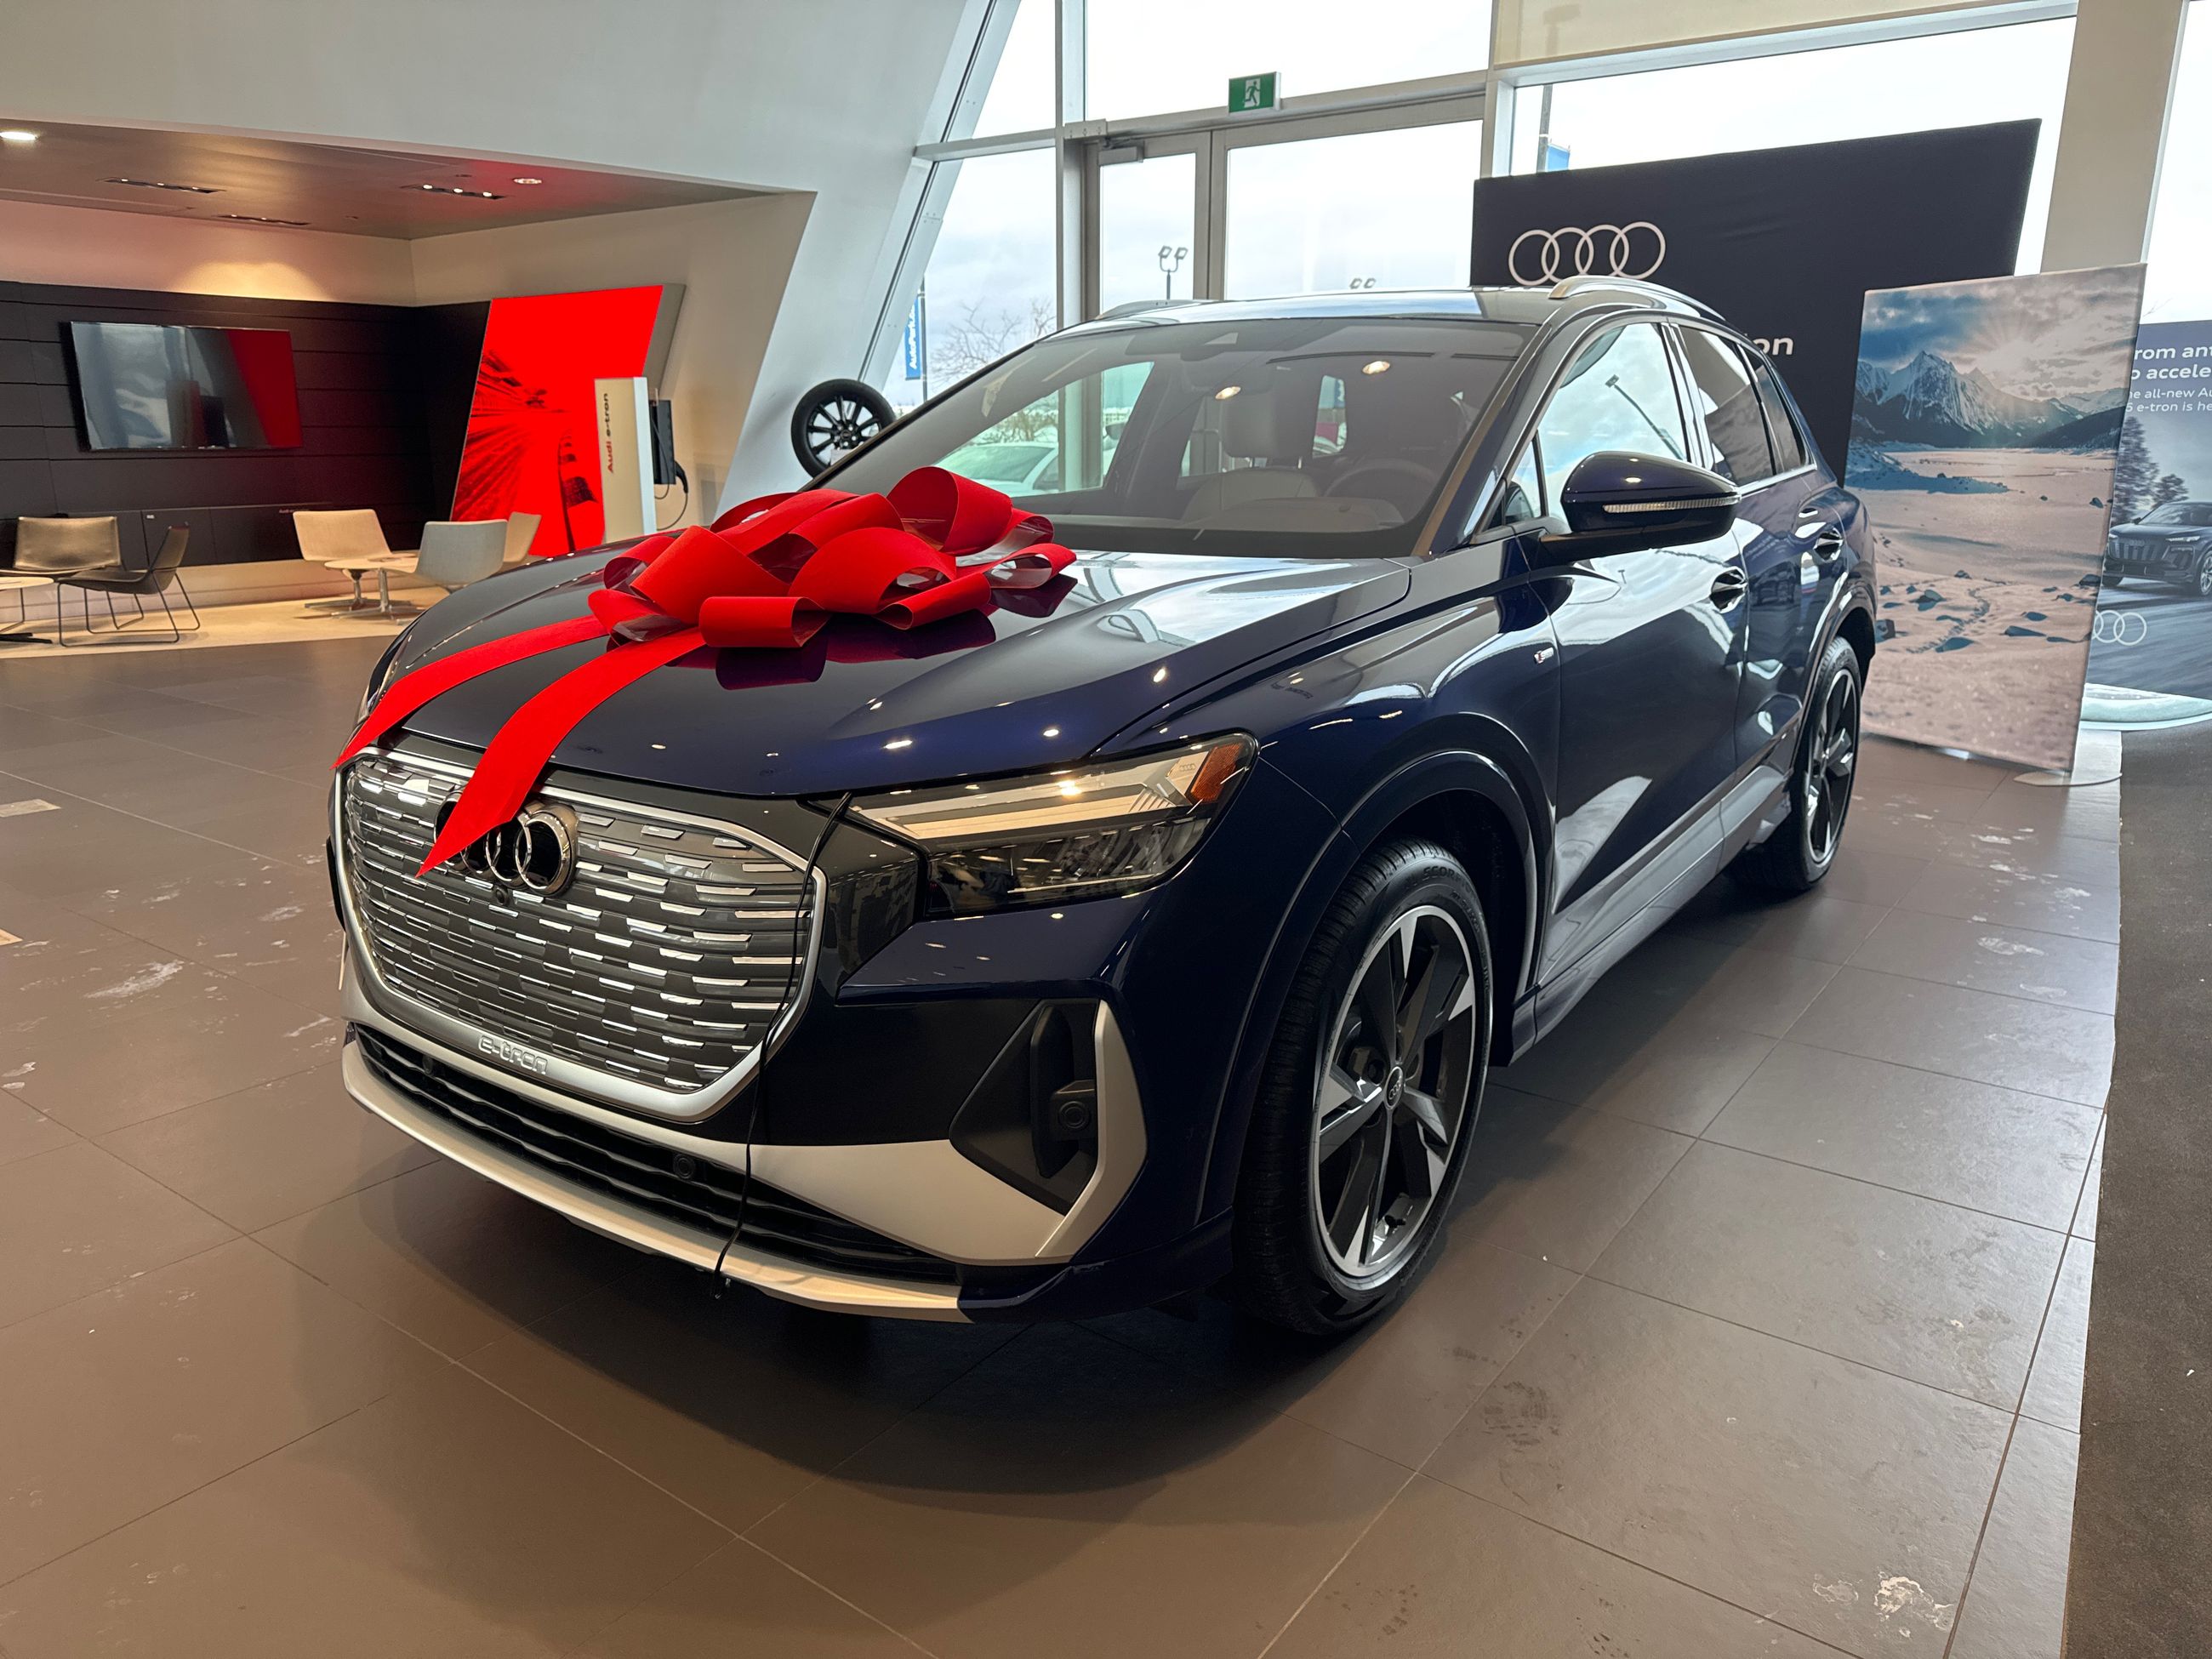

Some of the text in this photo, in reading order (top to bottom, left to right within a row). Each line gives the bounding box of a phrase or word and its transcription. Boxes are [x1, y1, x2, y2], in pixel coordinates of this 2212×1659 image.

[2146, 363, 2212, 379] accele
[2144, 388, 2195, 399] all-new
[2136, 402, 2178, 413] e-tron
[2181, 401, 2193, 412] is
[603, 393, 614, 474] Audi e-tron
[478, 1035, 548, 1075] e-tron
